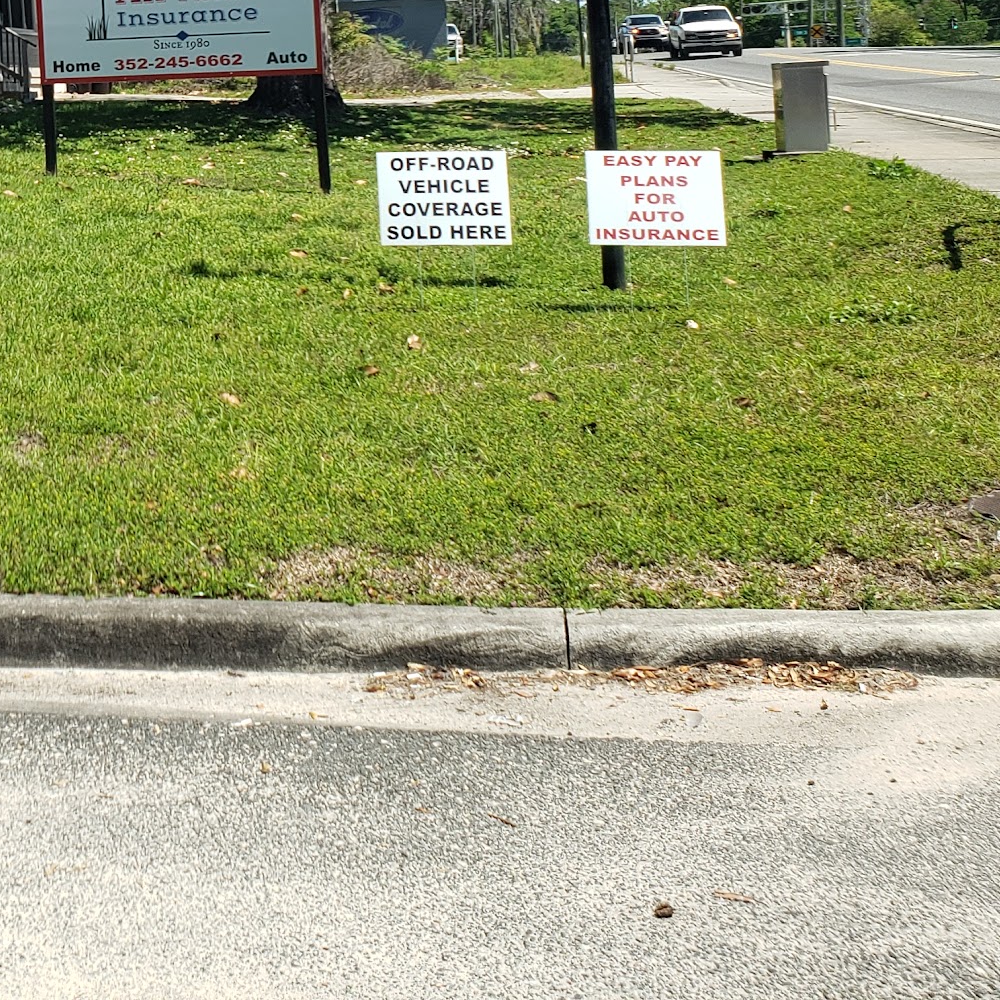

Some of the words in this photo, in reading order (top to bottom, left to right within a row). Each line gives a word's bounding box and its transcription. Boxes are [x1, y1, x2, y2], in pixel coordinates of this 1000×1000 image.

[117, 6, 258, 27] Insurance
[186, 38, 210, 50] 1980
[53, 59, 101, 73] Home
[114, 53, 243, 71] 352-245-6662
[266, 50, 308, 65] Auto
[390, 156, 494, 171] OFF-ROAD
[603, 155, 657, 167] EASY
[664, 155, 703, 167] PAY
[398, 179, 490, 194] VEHICLE
[620, 175, 689, 187] PLANS
[634, 193, 676, 205] FOR
[388, 202, 503, 217] COVERAGE
[628, 211, 685, 223] AUTO
[387, 225, 443, 240] SOLD
[450, 225, 507, 240] HERE
[596, 228, 720, 241] INSURANCE
